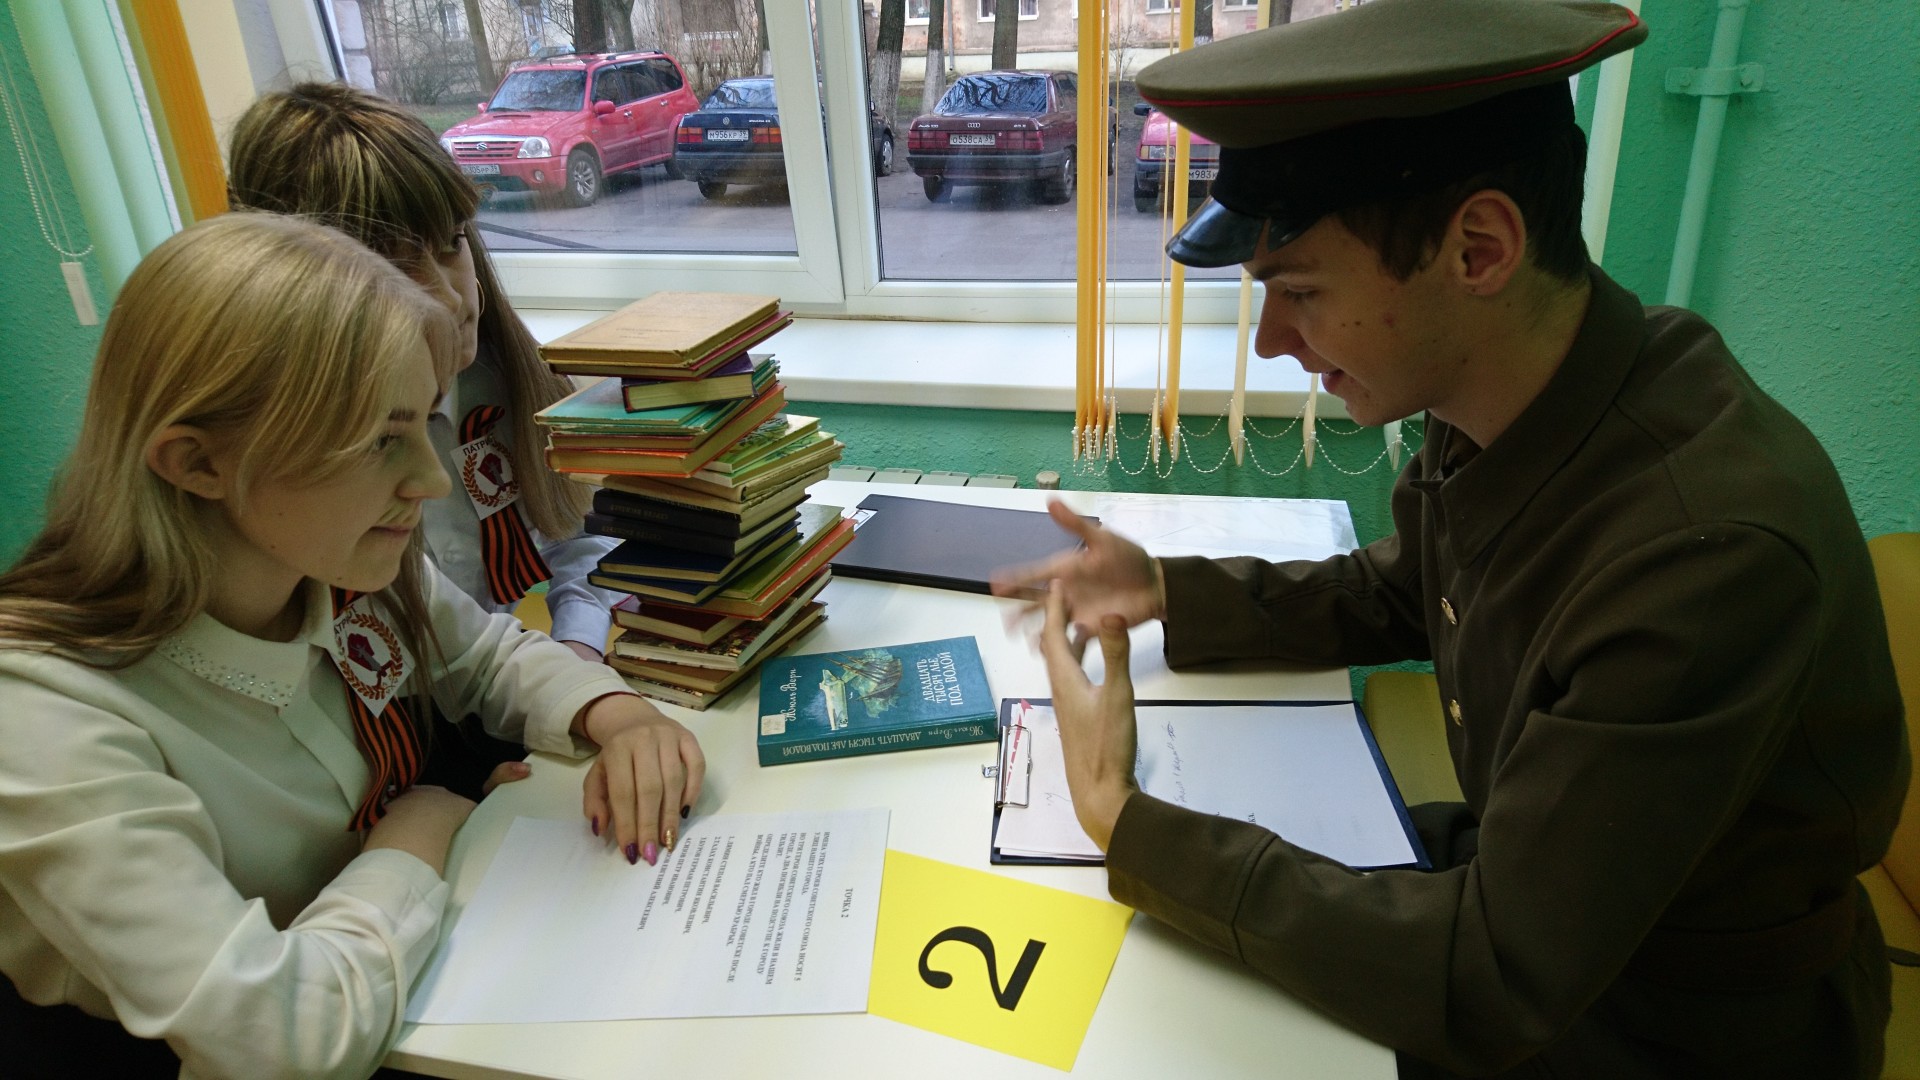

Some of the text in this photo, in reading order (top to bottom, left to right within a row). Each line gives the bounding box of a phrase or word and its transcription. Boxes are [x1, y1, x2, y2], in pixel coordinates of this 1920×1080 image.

[916, 658, 936, 702] ДВАДЦАТЬ
[928, 657, 947, 704] ТЫСЯЧ ЛЬЕ
[936, 651, 964, 706] ПОД ВОДОЙ
[780, 668, 802, 721] Жюль Верн
[849, 736, 876, 749] ТЫСЯЧ
[877, 731, 922, 746] ДВАДЦАТЬ
[928, 725, 984, 740] Жюль Верн
[831, 740, 847, 751] ЛЬЕ
[759, 833, 773, 868] ОПРЕДЕЛИТЕ
[822, 831, 830, 850] ИМЕНА
[674, 858, 684, 872] ПЕТР
[686, 857, 700, 880] ГЕРМАН
[748, 860, 756, 872] КТО
[793, 851, 802, 869] ГЕРОЯ
[807, 847, 817, 870] НАШЕГО
[818, 851, 826, 865] ЭТИХ
[654, 864, 669, 889] ЕВГЕНИЙ
[696, 858, 714, 895] КОНСТАНТИН
[715, 860, 727, 882] СТЕПАН
[744, 873, 753, 884] ПАЛ
[755, 869, 763, 881] КТО
[814, 866, 823, 886] ГЕРОЕВ
[751, 882, 760, 895] ЖИЛ
[776, 871, 787, 898] ПОГИБЛИ
[784, 870, 798, 907] СОВЕТСКОГО
[736, 885, 749, 914] СМЕРТЬЮ
[773, 899, 781, 908] НА
[806, 888, 819, 926] СОВЕТСКОГО
[843, 888, 853, 912] ТОЧКА
[744, 901, 755, 923] ГОРОДЕ
[779, 908, 789, 930] СОЮЗА
[765, 908, 778, 941] ПОДСТУПЕ
[734, 925, 748, 958] СОВЕТСКЕ
[774, 931, 784, 950] ЖИЛИ
[801, 928, 811, 951] СОЮЗА
[728, 959, 739, 982] ПОСЛЕ
[757, 948, 769, 974] ГОРОДУ
[766, 958, 778, 984] НАШЕМ
[796, 952, 806, 975] НОСЯТ
[918, 925, 1047, 1012] 2
